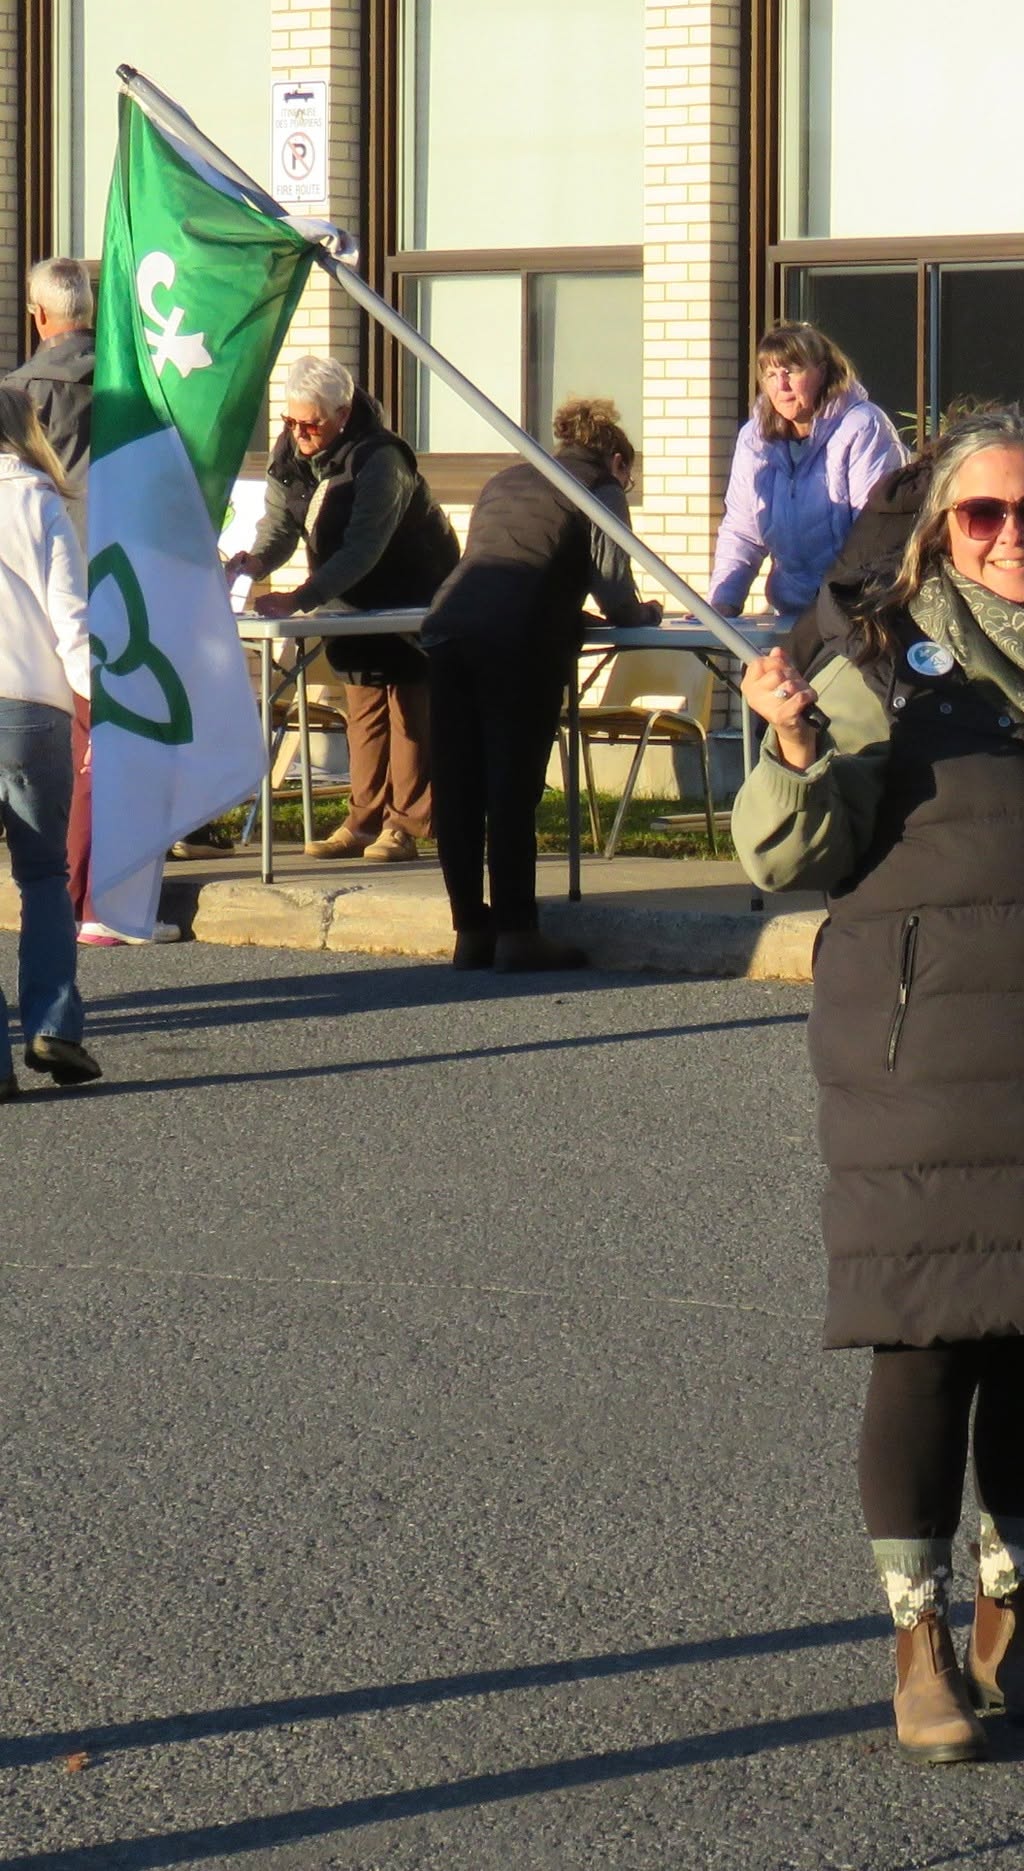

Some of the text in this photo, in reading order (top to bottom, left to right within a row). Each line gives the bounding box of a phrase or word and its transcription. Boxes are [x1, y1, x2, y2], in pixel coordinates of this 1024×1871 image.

[292, 143, 307, 170] P
[276, 183, 321, 195] FIRE ROUTE
